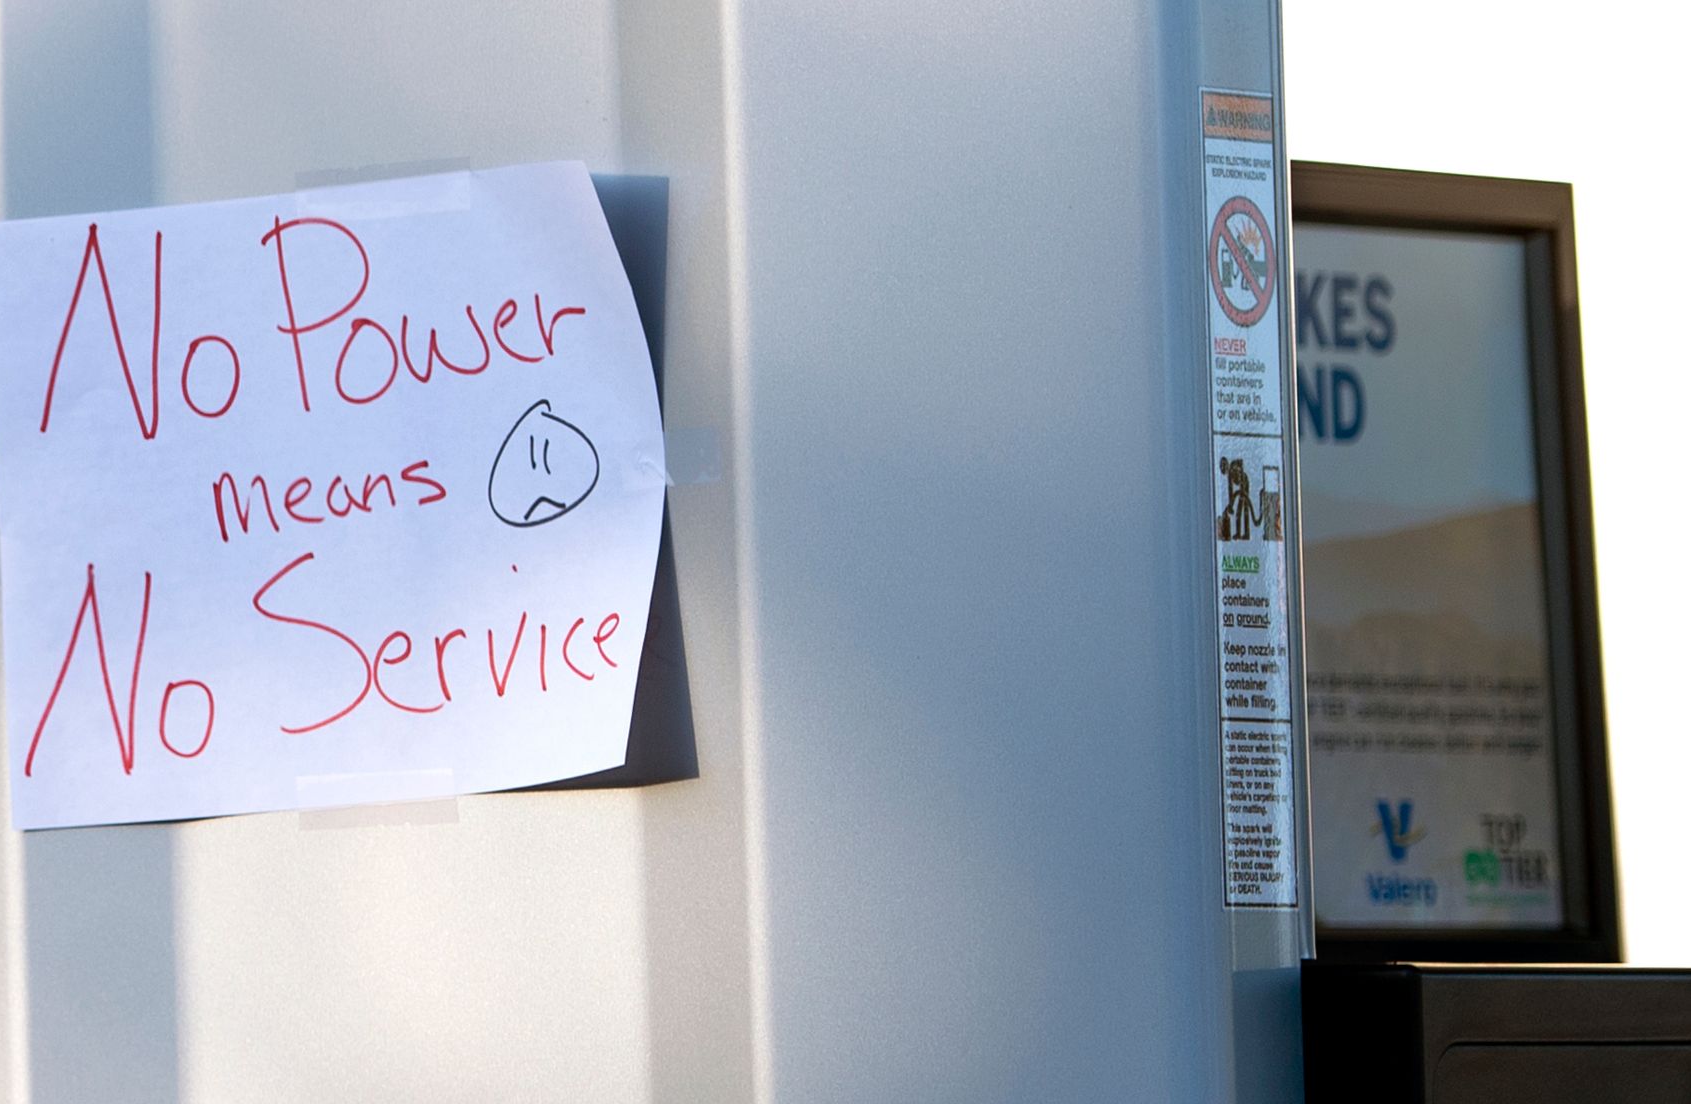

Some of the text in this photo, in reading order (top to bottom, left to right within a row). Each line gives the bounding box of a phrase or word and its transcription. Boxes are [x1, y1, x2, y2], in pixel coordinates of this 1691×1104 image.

[1218, 109, 1270, 131] WARNING
[1207, 154, 1224, 163] STATIC
[1225, 155, 1252, 166] ELECTRIC
[1212, 168, 1267, 181] EXPLOSION HAZARD
[39, 215, 586, 440] No Power
[1214, 337, 1246, 352] NEVER
[1216, 357, 1265, 372] fill portable
[1217, 375, 1263, 388] containers
[1217, 391, 1261, 405] that are in
[1217, 408, 1276, 423] or on vehicle.
[212, 459, 448, 542] means
[1222, 555, 1260, 569] ALWAYS
[1222, 576, 1246, 590] place
[1223, 594, 1270, 607] containers
[1223, 613, 1271, 626] on ground.
[1224, 642, 1286, 657] Keep nozzle in
[24, 551, 621, 776] No Service
[1225, 660, 1279, 673] contact with
[1225, 677, 1267, 690] container
[1225, 692, 1249, 708] while
[1231, 731, 1246, 740] static
[1248, 731, 1269, 740] electric
[1256, 743, 1270, 752] when
[1226, 756, 1249, 765] portable
[1254, 768, 1268, 777] truck
[1264, 782, 1274, 791] any
[1227, 823, 1272, 832] This spark will
[1234, 849, 1260, 858] gasoline
[1228, 860, 1239, 869] fire
[1241, 861, 1252, 869] and
[1229, 872, 1284, 881] SERIOUS INJURY
[1366, 873, 1437, 905] Valero
